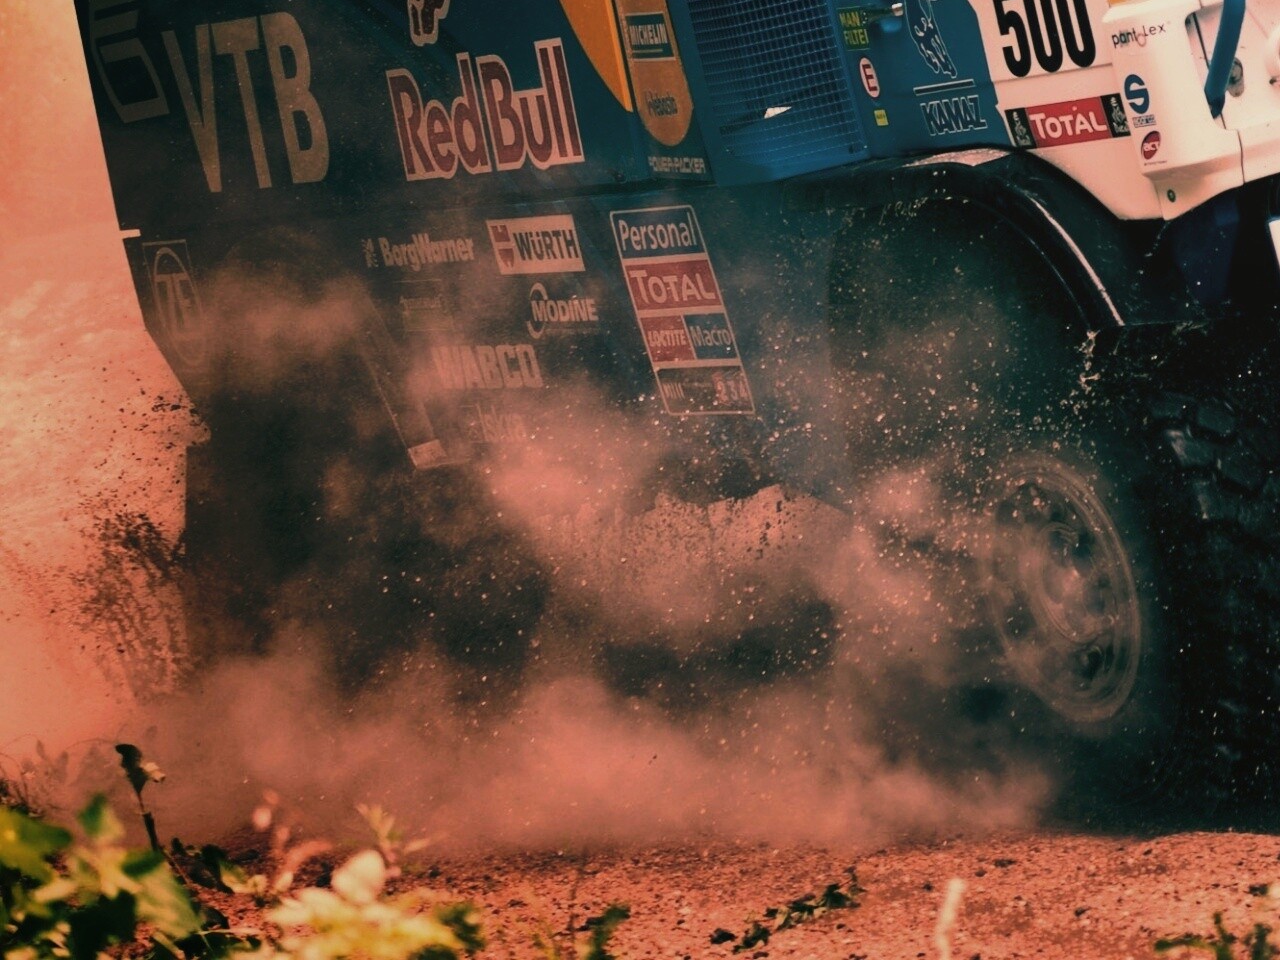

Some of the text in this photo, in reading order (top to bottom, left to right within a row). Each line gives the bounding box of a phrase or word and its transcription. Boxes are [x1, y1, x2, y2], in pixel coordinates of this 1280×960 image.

[629, 23, 668, 46] MICHELIN
[161, 11, 329, 193] VTB
[387, 39, 583, 179] Red Bull
[920, 95, 987, 136] KAMAZ
[1029, 110, 1108, 140] TOTAL
[379, 233, 475, 272] BorgWarner
[512, 227, 579, 262] WÜRTH
[618, 216, 698, 253] Personal
[629, 269, 717, 304] TOTAL
[531, 296, 599, 323] MODINE
[647, 325, 732, 347] LOCTITE Macro
[433, 344, 543, 389] WABCO
